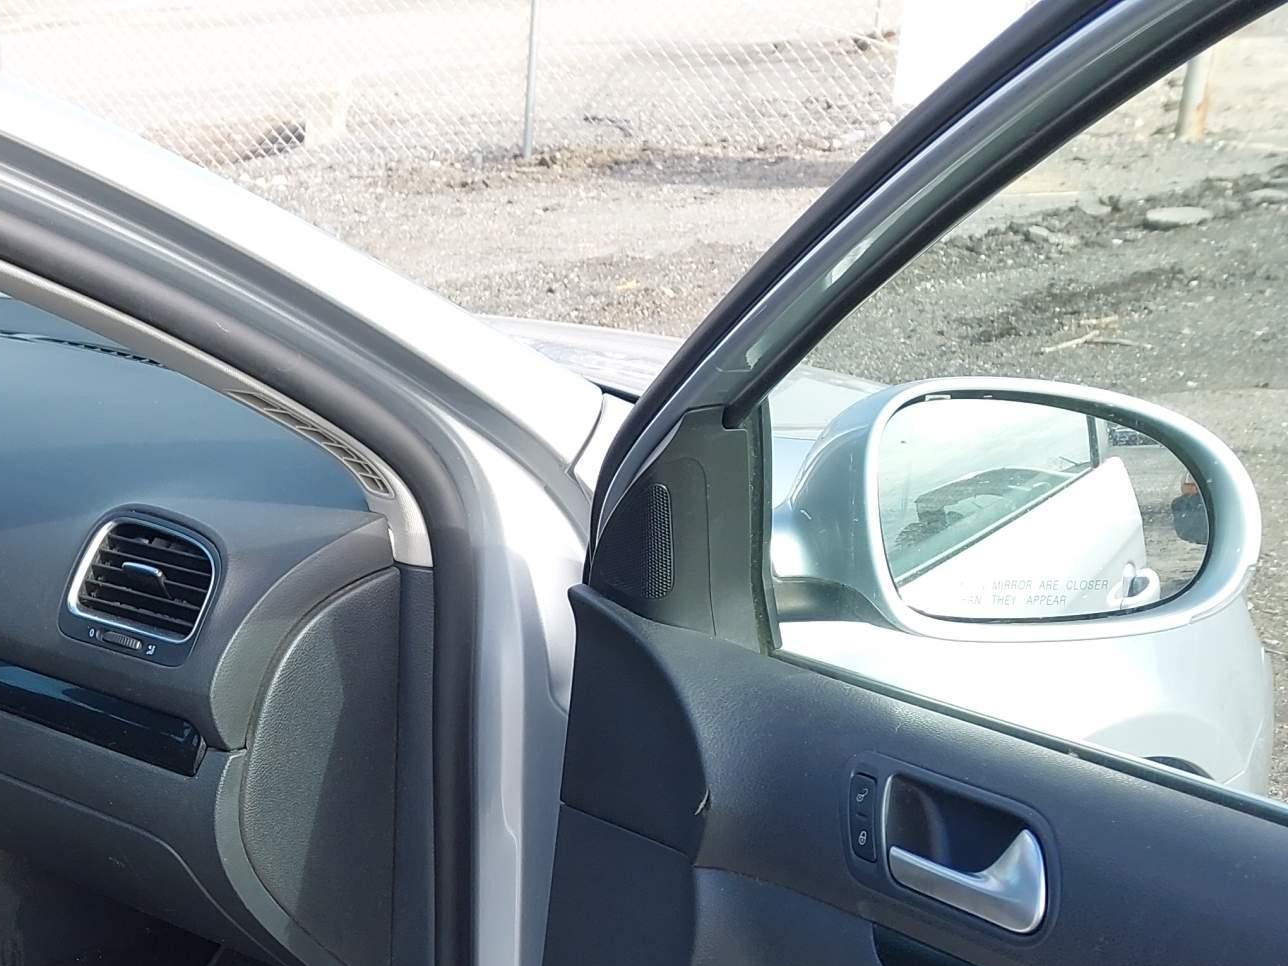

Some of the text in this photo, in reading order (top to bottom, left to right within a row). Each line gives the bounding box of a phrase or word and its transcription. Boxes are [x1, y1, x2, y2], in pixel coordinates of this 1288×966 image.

[991, 579, 1033, 591] MIRROR
[1038, 580, 1060, 591] ARE
[1065, 579, 1109, 591] CLOSER
[991, 595, 1017, 606] THEY
[1025, 595, 1067, 606] APPEAR
